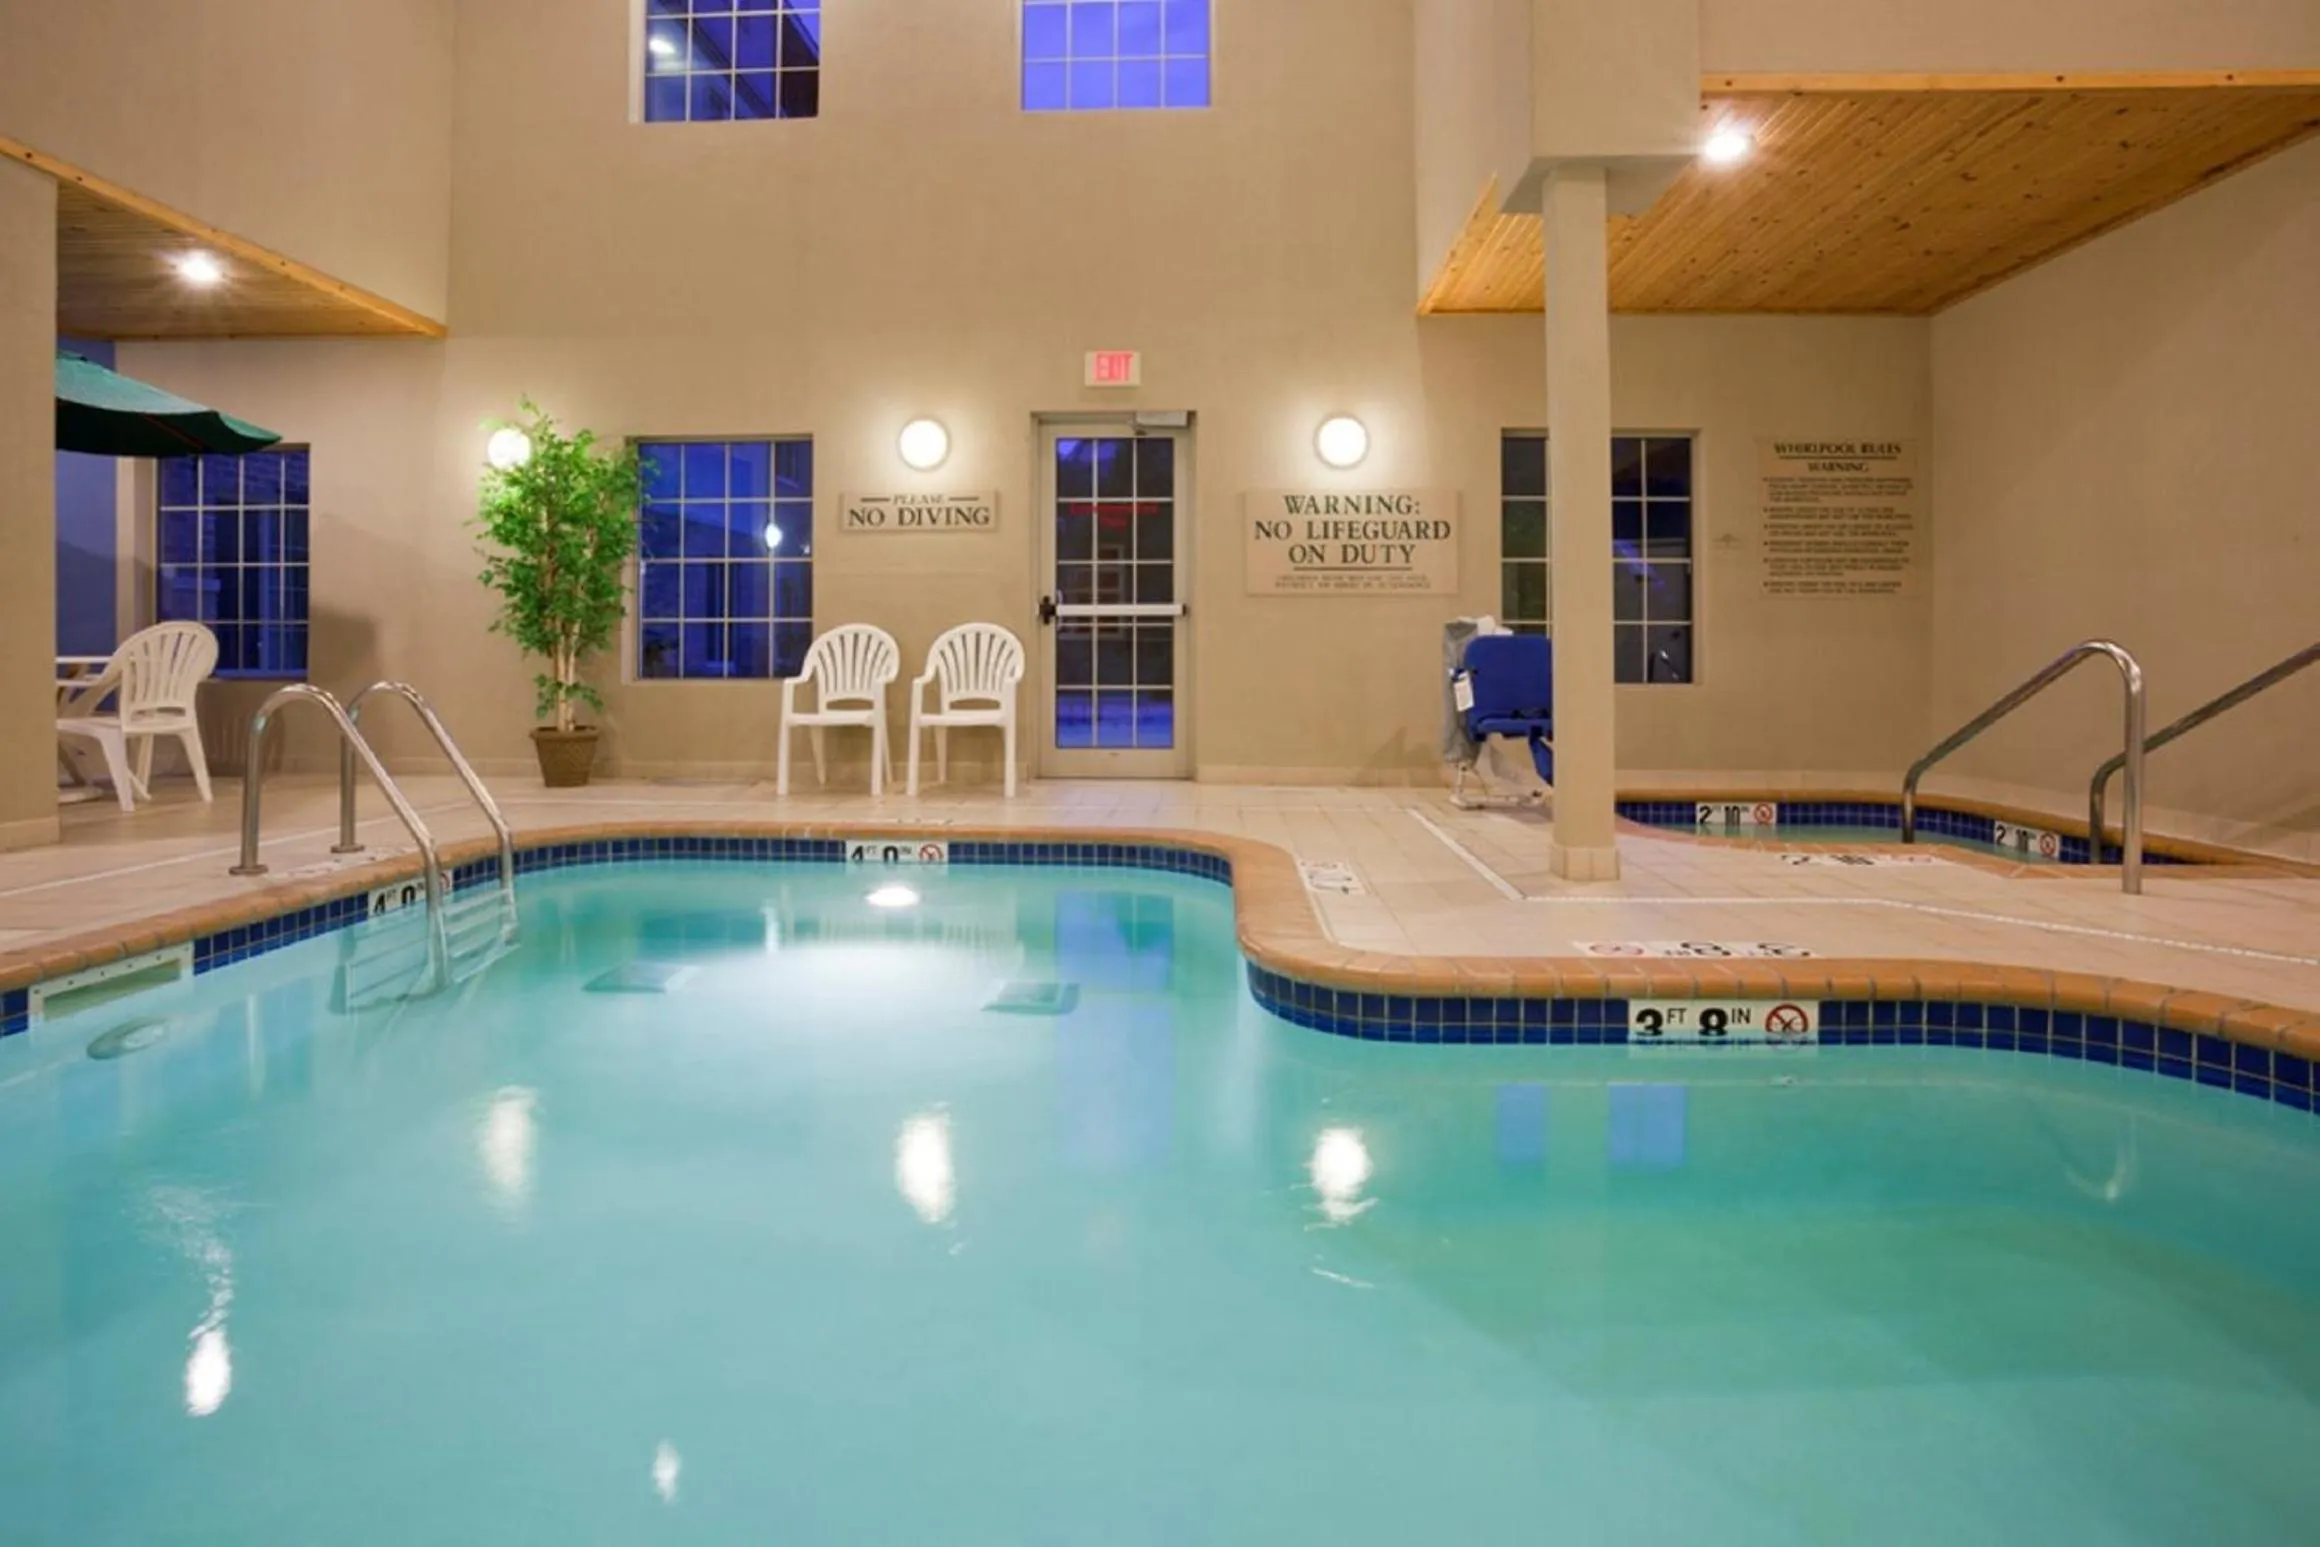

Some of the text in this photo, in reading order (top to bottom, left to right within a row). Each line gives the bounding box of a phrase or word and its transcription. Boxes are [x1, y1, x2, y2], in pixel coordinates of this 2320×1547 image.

[1096, 354, 1133, 381] EXIT
[893, 494, 944, 505] PLEASE
[1283, 494, 1421, 516] WARNING:
[848, 506, 991, 527] NO DIVING
[1254, 520, 1452, 541] NO LIFEGUARD
[1288, 543, 1417, 565] ON DUTY
[1635, 1007, 1751, 1036] 3 FT 8 IN
